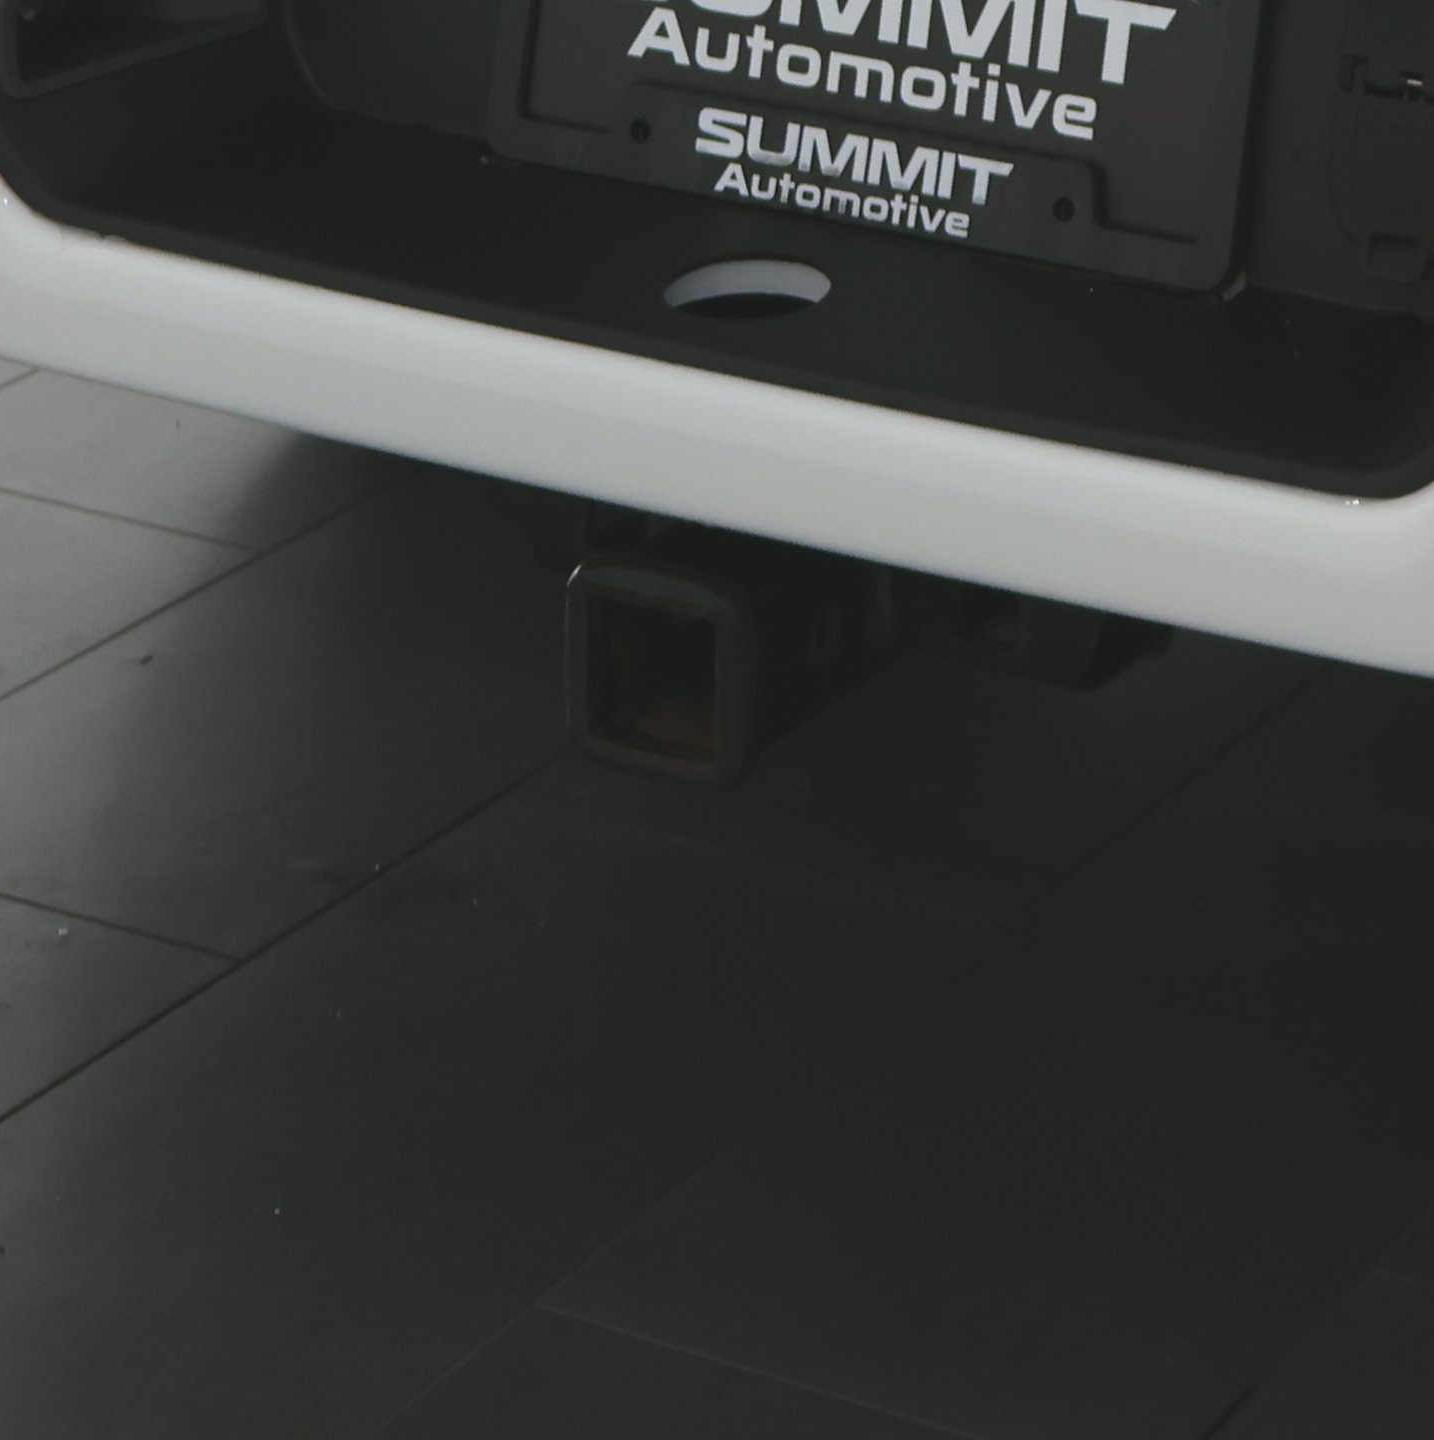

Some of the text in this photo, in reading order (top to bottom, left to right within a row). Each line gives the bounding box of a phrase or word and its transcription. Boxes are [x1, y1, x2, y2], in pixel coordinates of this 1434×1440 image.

[627, 6, 1099, 142] Automotive
[693, 107, 1015, 206] SUMMIT
[713, 162, 971, 239] Automotive
